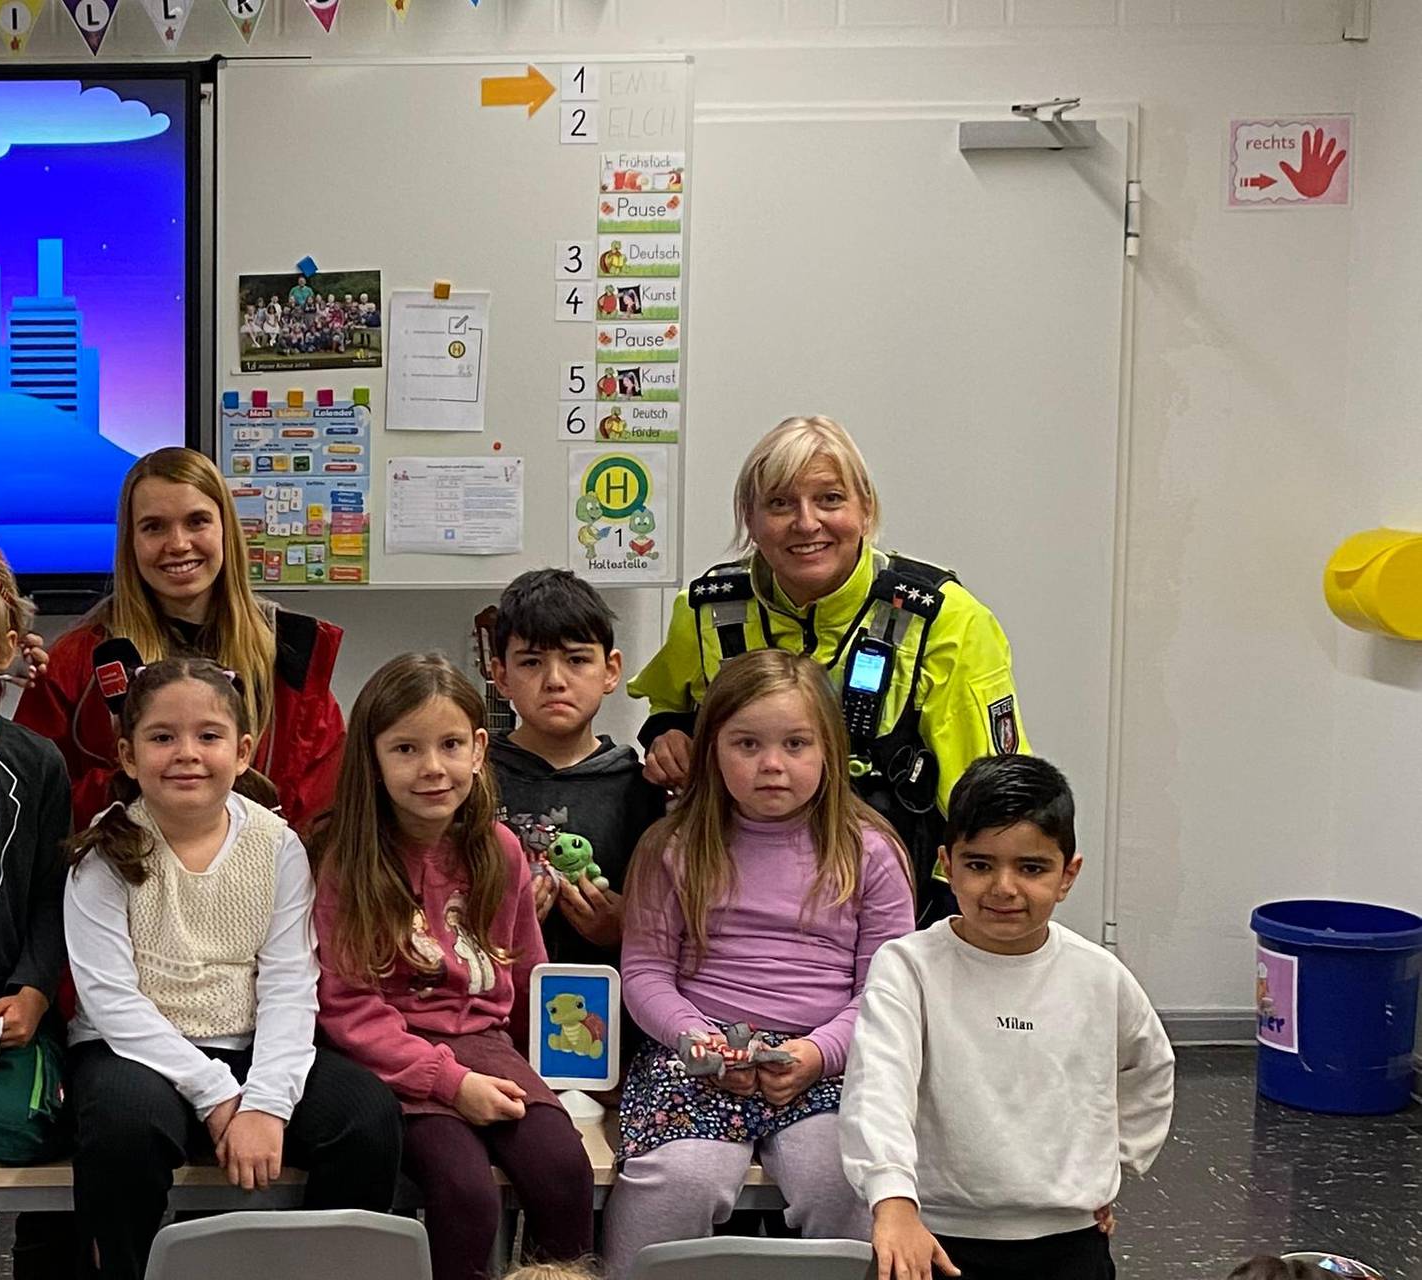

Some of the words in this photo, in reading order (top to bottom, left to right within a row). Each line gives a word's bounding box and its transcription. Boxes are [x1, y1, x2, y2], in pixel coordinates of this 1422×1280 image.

[573, 66, 585, 93] 1
[570, 108, 587, 136] 2
[607, 106, 677, 140] ELCH
[1245, 134, 1296, 150] rechts
[618, 153, 672, 168] Frühstück
[617, 197, 667, 217] Pause
[564, 245, 583, 273] 3
[629, 244, 680, 260] Deutsch
[565, 287, 584, 315] 4
[641, 286, 677, 302] Kunst
[615, 327, 665, 347] Pause
[568, 366, 586, 394] 5
[641, 368, 677, 384] Kunst
[566, 406, 586, 434] 6
[632, 407, 668, 420] Deutsch
[606, 472, 628, 504] H
[614, 528, 623, 548] 1
[588, 559, 648, 570] Haltestelle
[995, 1016, 1035, 1031] Milan
